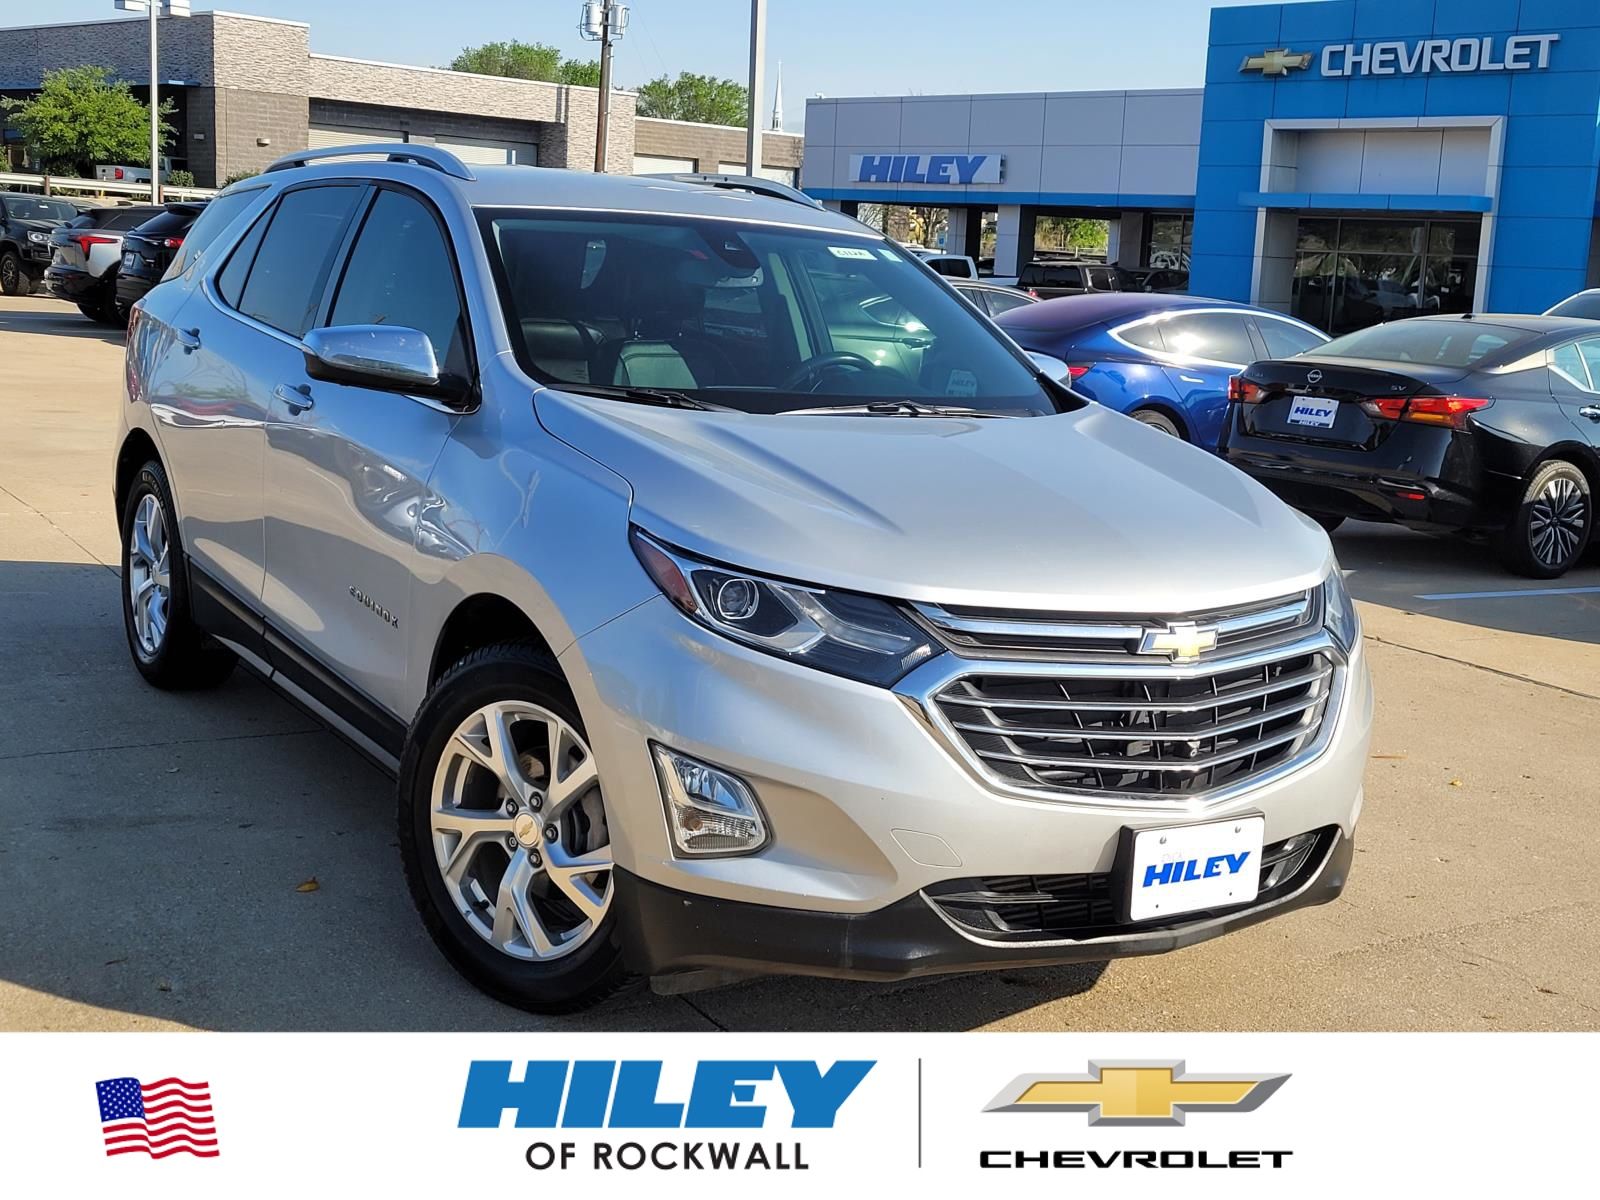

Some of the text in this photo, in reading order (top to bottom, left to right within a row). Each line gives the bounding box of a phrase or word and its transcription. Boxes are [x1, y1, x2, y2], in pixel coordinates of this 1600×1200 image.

[1320, 33, 1561, 77] CHEVROLET
[858, 155, 988, 184] HILEY
[1294, 406, 1332, 417] HILEY
[349, 585, 398, 629] EQUINOX
[1142, 851, 1251, 888] HILEY
